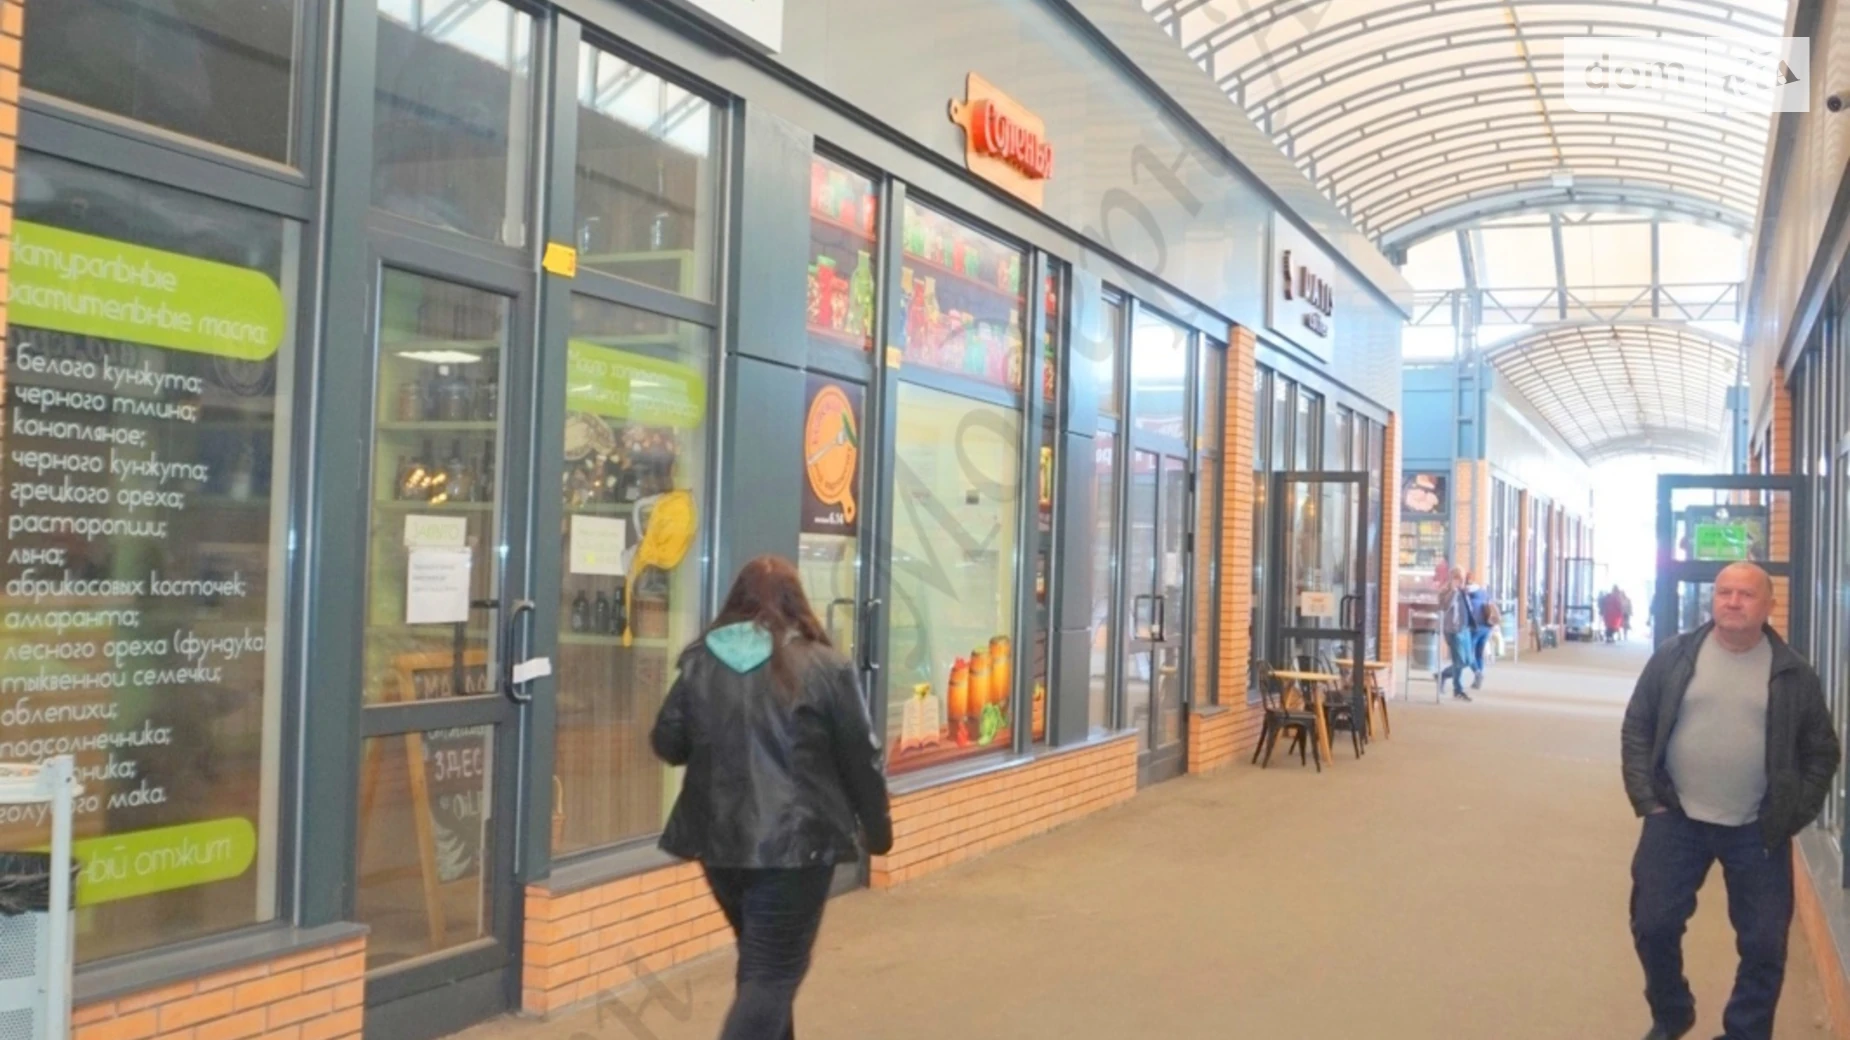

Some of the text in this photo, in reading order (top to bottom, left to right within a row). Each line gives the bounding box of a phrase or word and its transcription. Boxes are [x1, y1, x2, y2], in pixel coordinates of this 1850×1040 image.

[16, 343, 96, 379] белого
[103, 354, 204, 394] кунжута;
[14, 385, 198, 423] черного тмина;
[13, 406, 146, 447] конопляное;
[11, 447, 209, 485] черного кунжута;
[9, 474, 186, 513] грецкого ореха;
[8, 514, 168, 541] расторопши;
[7, 547, 67, 567] льна;
[5, 568, 247, 602] абрикосовых косточек;
[4, 609, 141, 635] амаранта;
[3, 627, 267, 667] лесного ореха (фундука
[2, 662, 223, 693] тыквенной семечки;
[1, 697, 118, 727] облепихи;
[0, 719, 173, 763] подсолнечника;
[0, 778, 168, 827] голуго мака.
[134, 836, 233, 877] отжим
